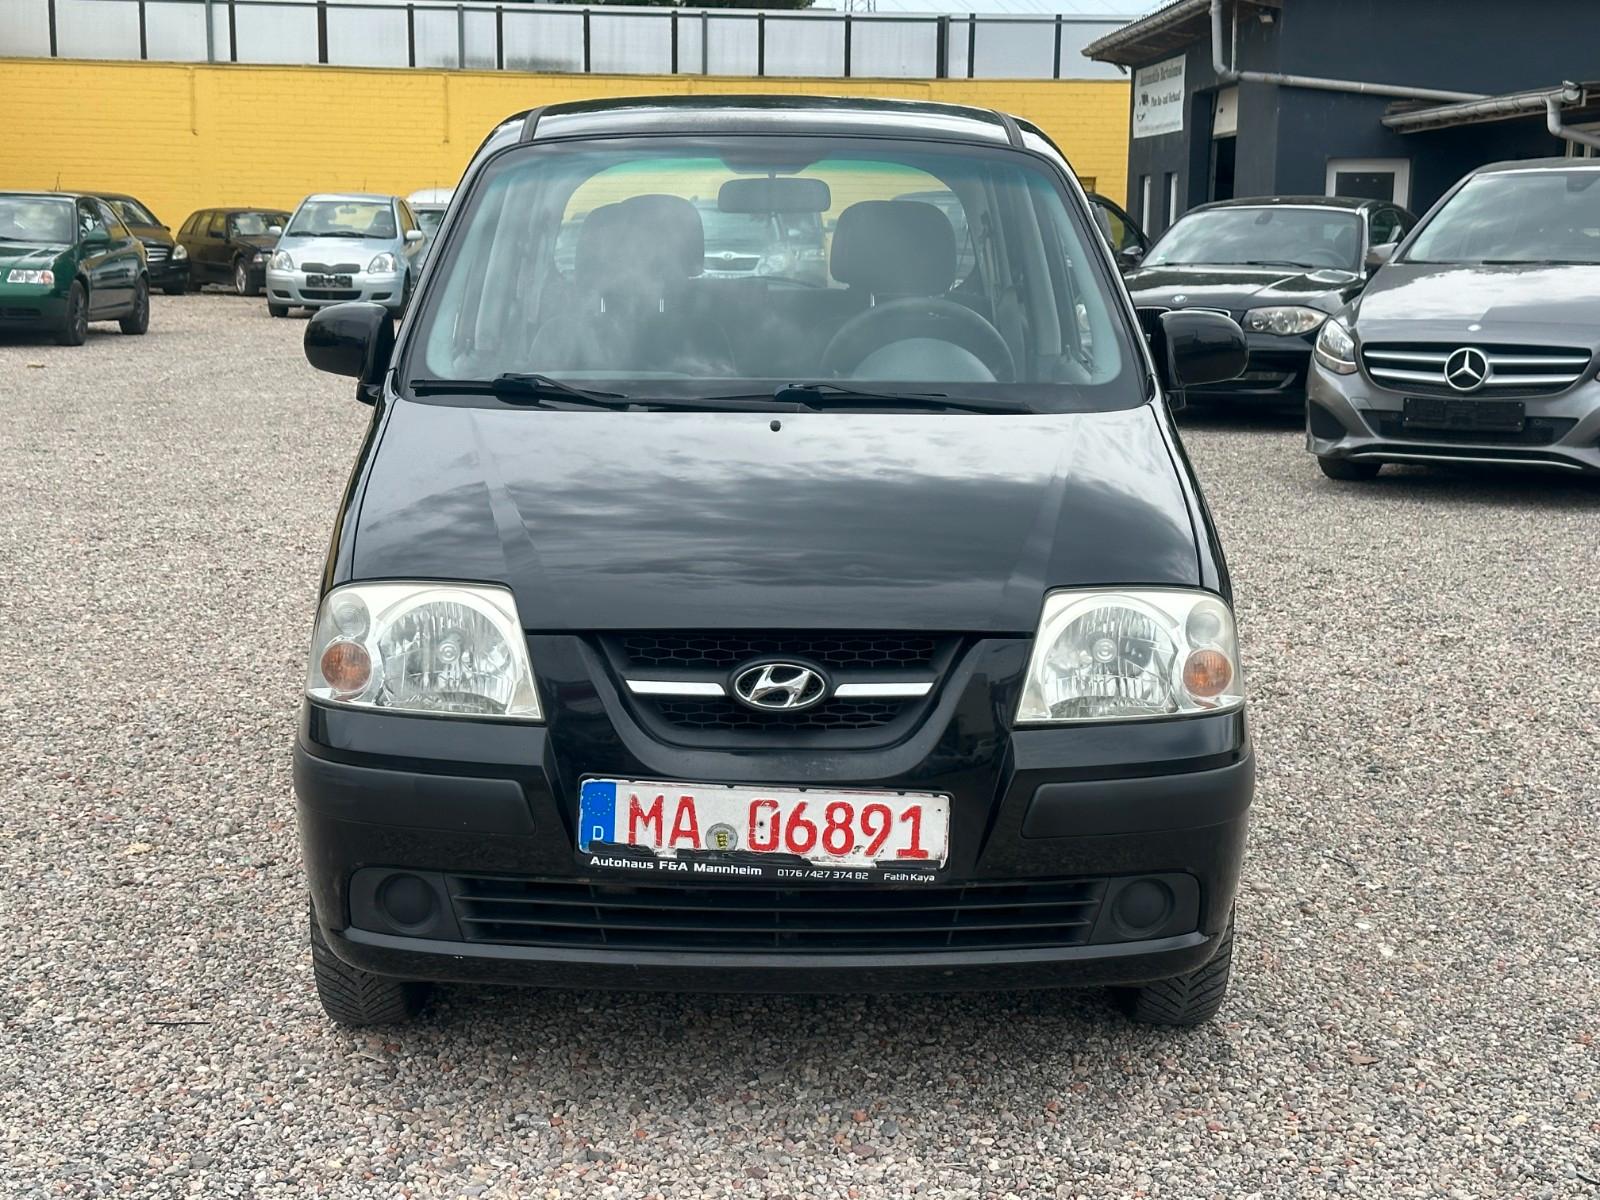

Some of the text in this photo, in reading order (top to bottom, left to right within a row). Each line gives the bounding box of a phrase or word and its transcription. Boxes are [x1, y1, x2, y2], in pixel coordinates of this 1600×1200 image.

[592, 825, 604, 841] D
[627, 794, 701, 849] MA
[747, 798, 930, 860] 06891
[590, 856, 762, 876] Autohaus F&A Mannheim
[777, 868, 803, 878] 0176
[833, 871, 853, 880] 374
[855, 872, 869, 880] 82
[883, 873, 935, 884] Fatih Kaya
